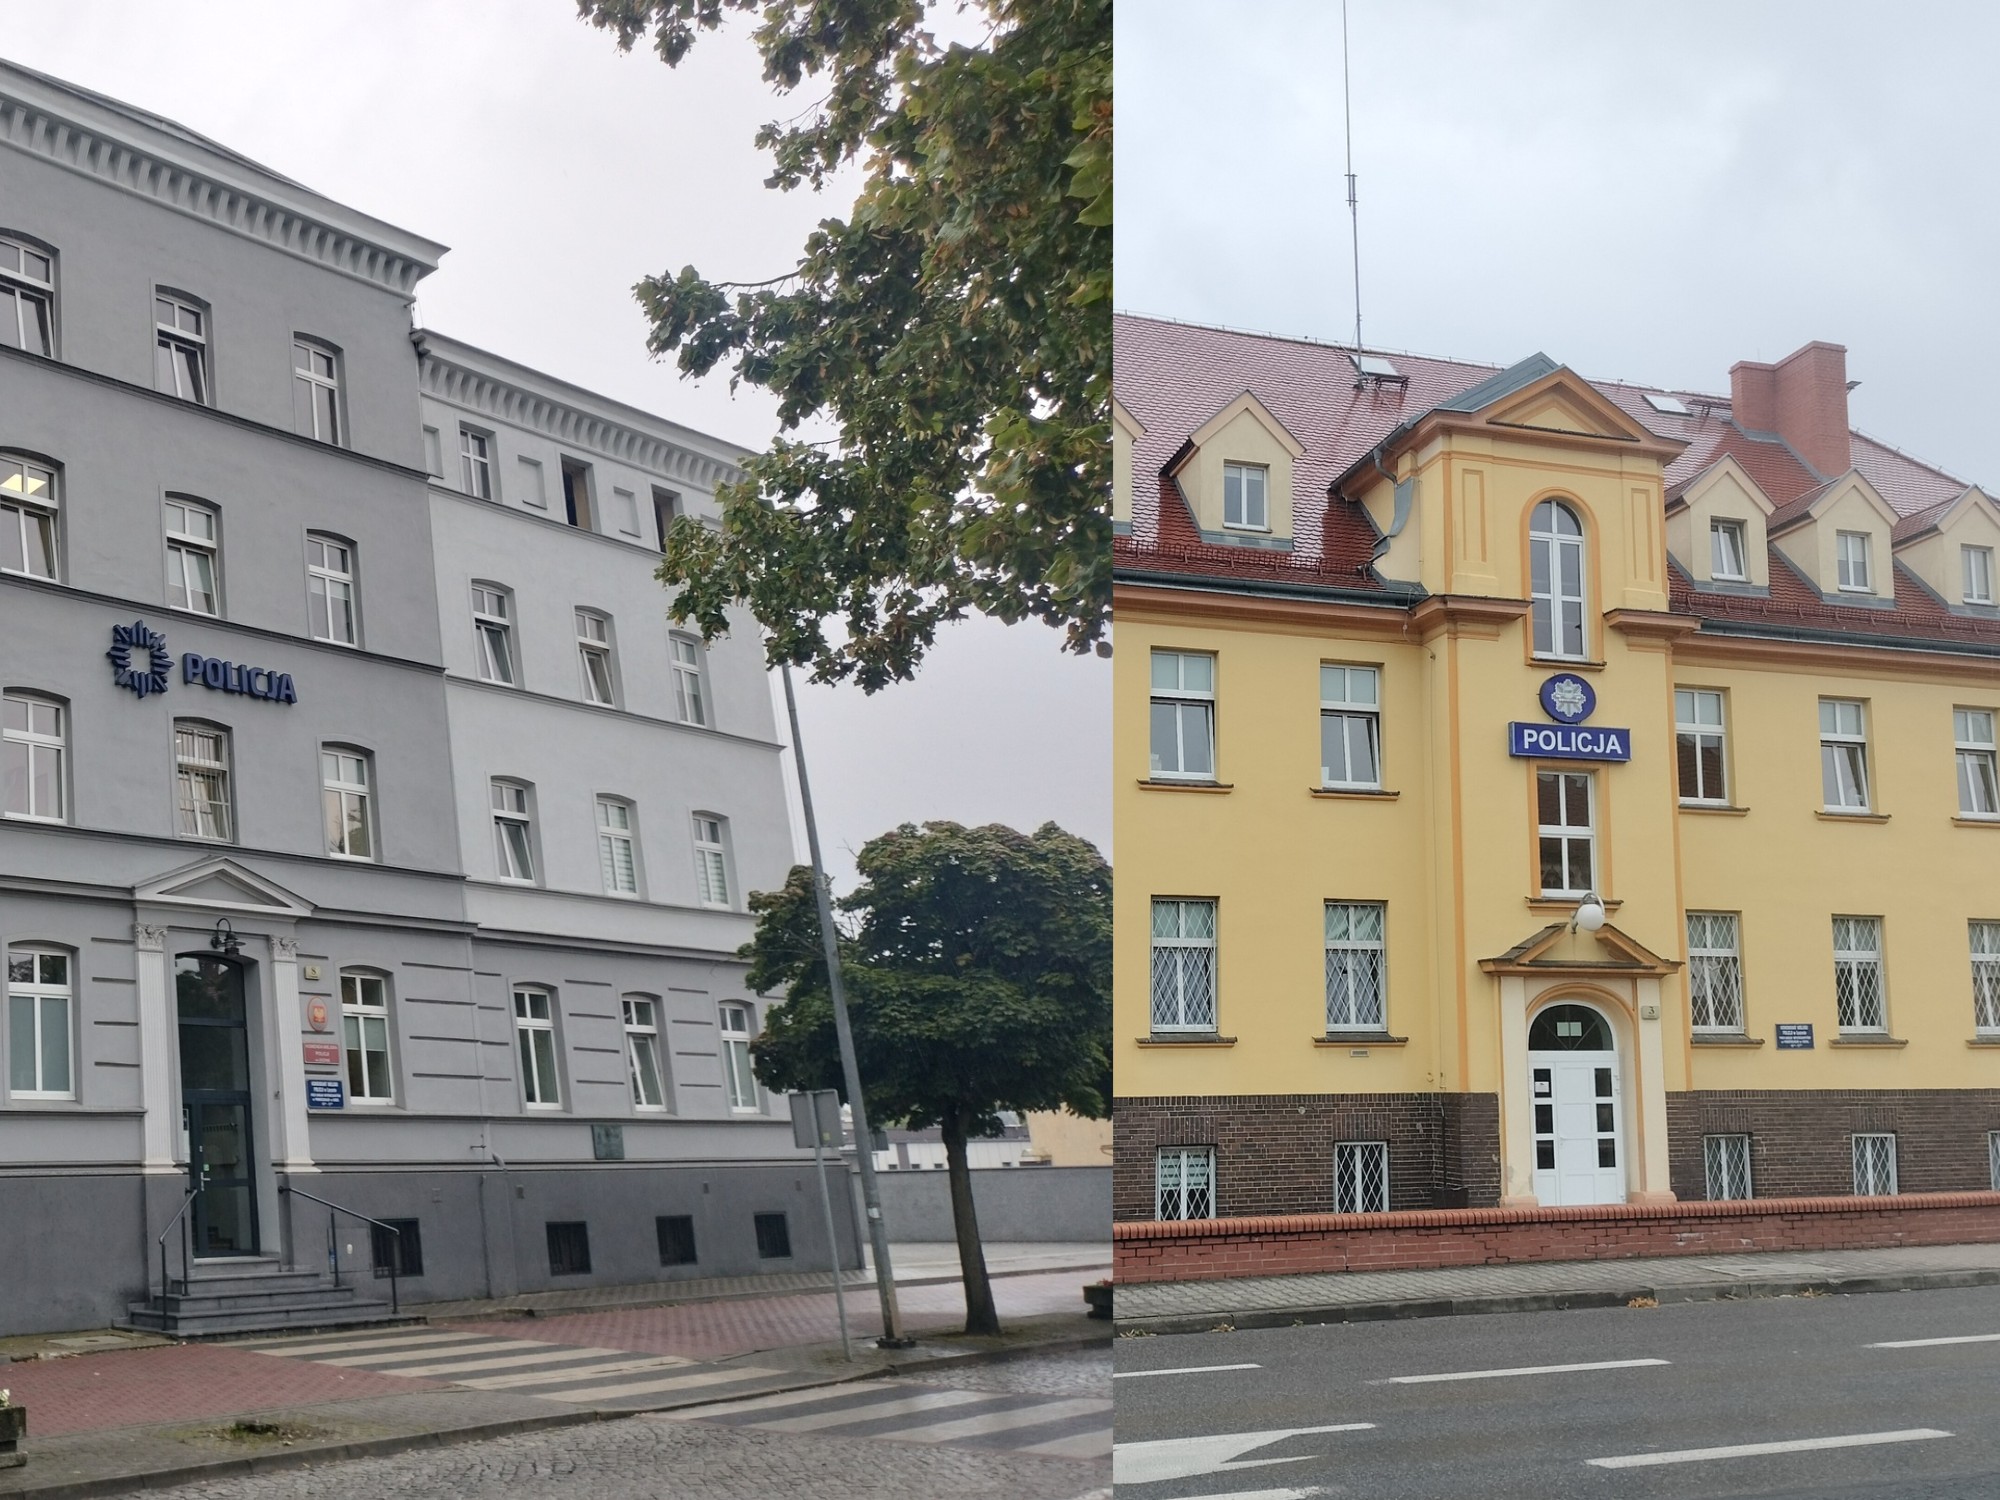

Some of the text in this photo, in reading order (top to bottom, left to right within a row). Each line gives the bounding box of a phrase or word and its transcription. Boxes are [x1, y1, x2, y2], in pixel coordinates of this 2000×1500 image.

[182, 652, 298, 704] POLICJA
[1523, 728, 1623, 755] POLICJA
[1648, 1006, 1655, 1015] 3
